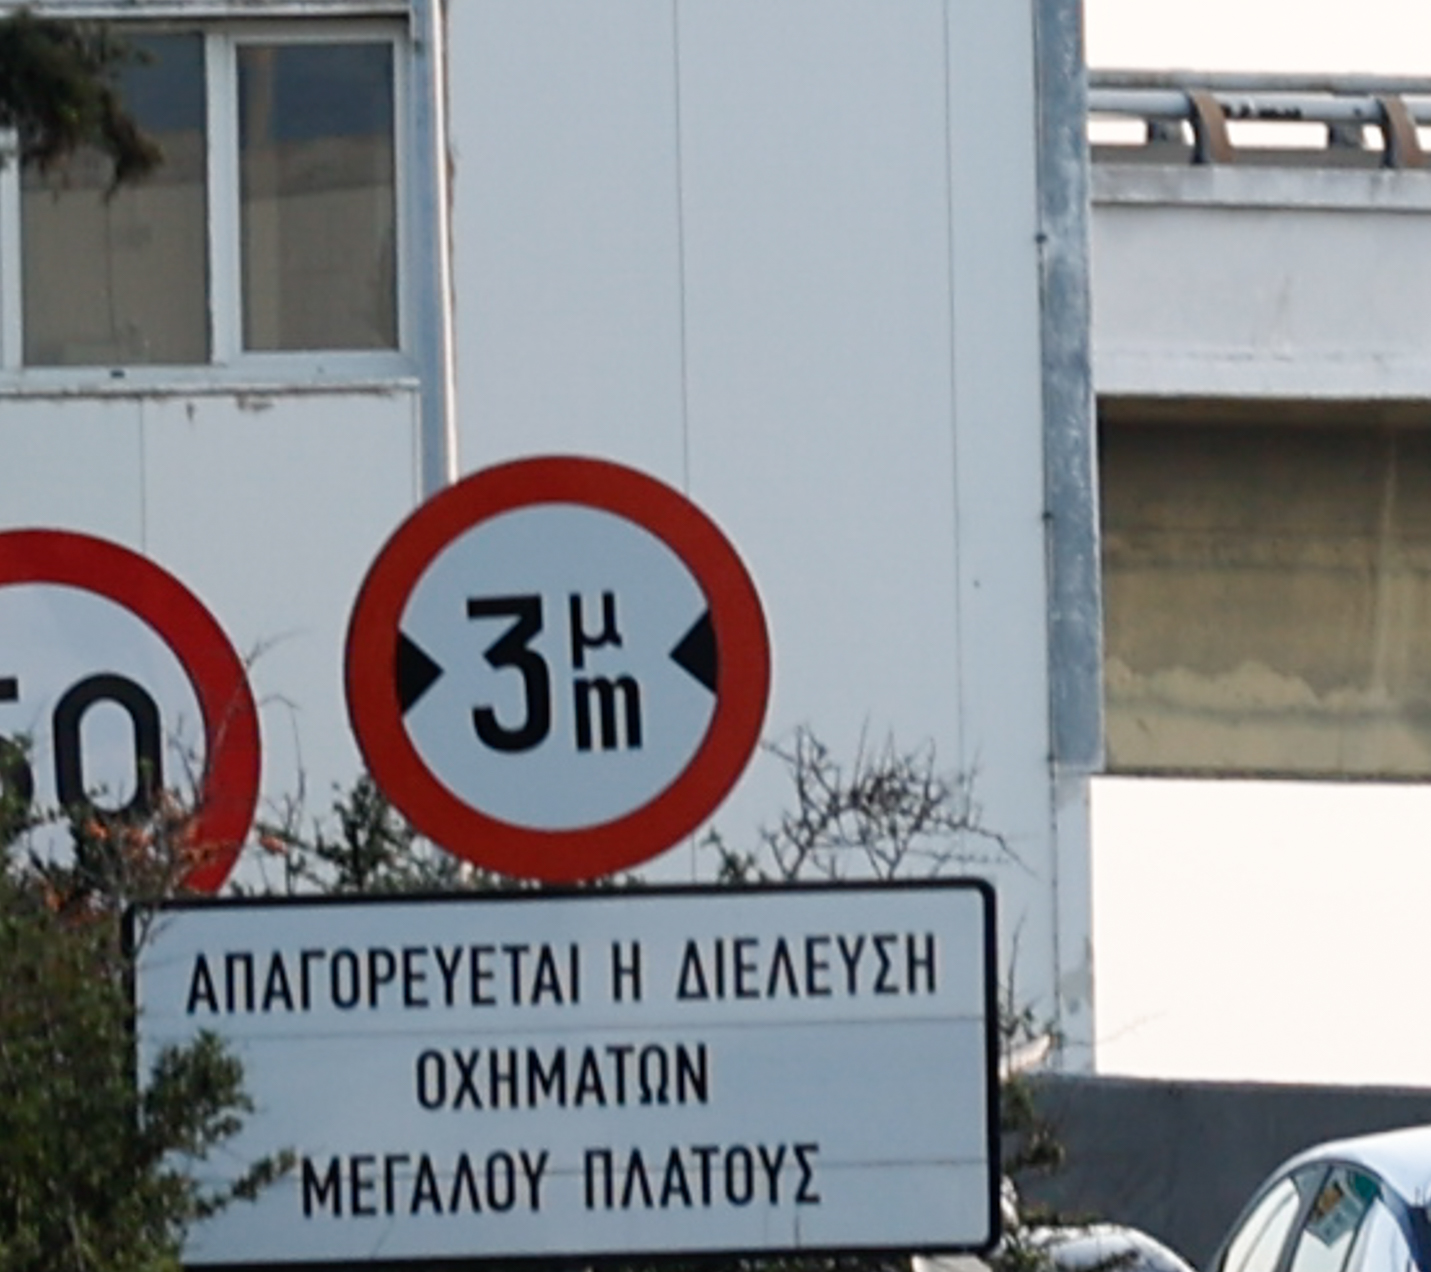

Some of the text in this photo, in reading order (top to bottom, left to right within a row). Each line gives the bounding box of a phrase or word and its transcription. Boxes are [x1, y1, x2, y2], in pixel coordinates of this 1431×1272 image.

[466, 593, 552, 755] 3
[572, 673, 643, 753] m
[185, 932, 937, 1016] ΑΠΑΓΟΡΕΥΕΤΑΙ Η ΔΙΕΛΕΥΣΗ
[415, 1042, 709, 1112] ΟΧΗΜΑΤΩΝ
[300, 1142, 822, 1219] ΜΕΓΑΛΟΥ ΠΛΑΤΟΥΣ
